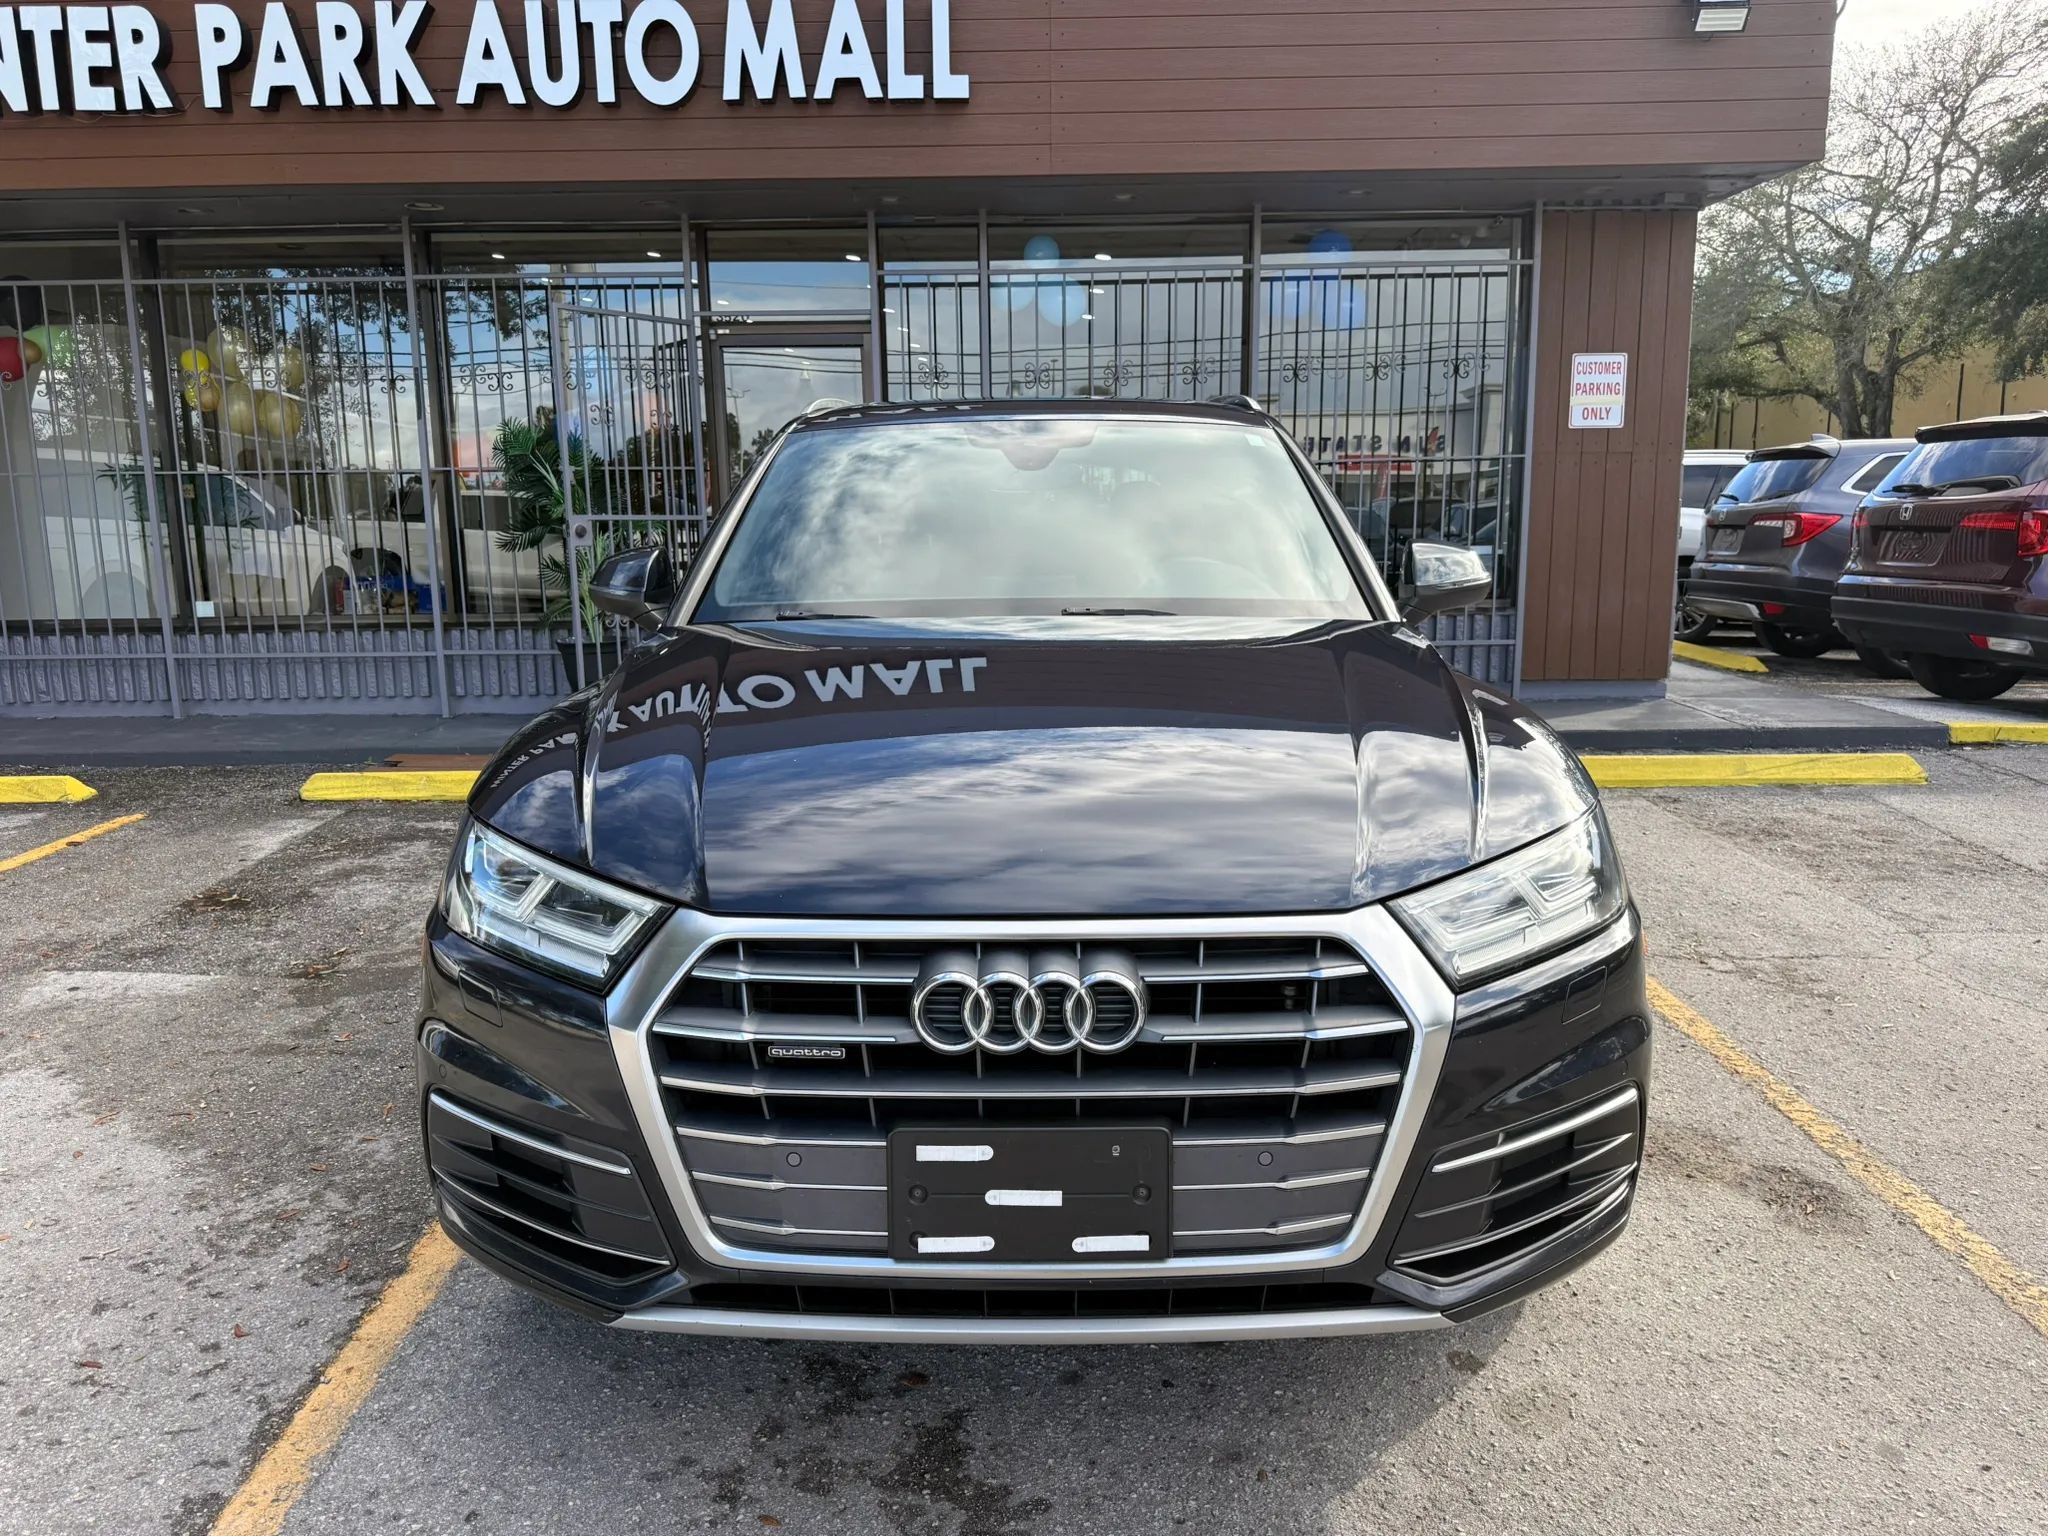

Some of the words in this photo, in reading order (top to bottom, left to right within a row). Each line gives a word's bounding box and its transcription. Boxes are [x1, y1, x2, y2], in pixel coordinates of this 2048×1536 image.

[194, 0, 436, 109] PARK
[456, 0, 700, 107] AUTO
[722, 0, 970, 101] MALL
[1576, 361, 1622, 375] CUSTOMER
[1575, 382, 1621, 396] PARKING
[1582, 406, 1612, 420] ONLY
[771, 1048, 842, 1057] quattro
